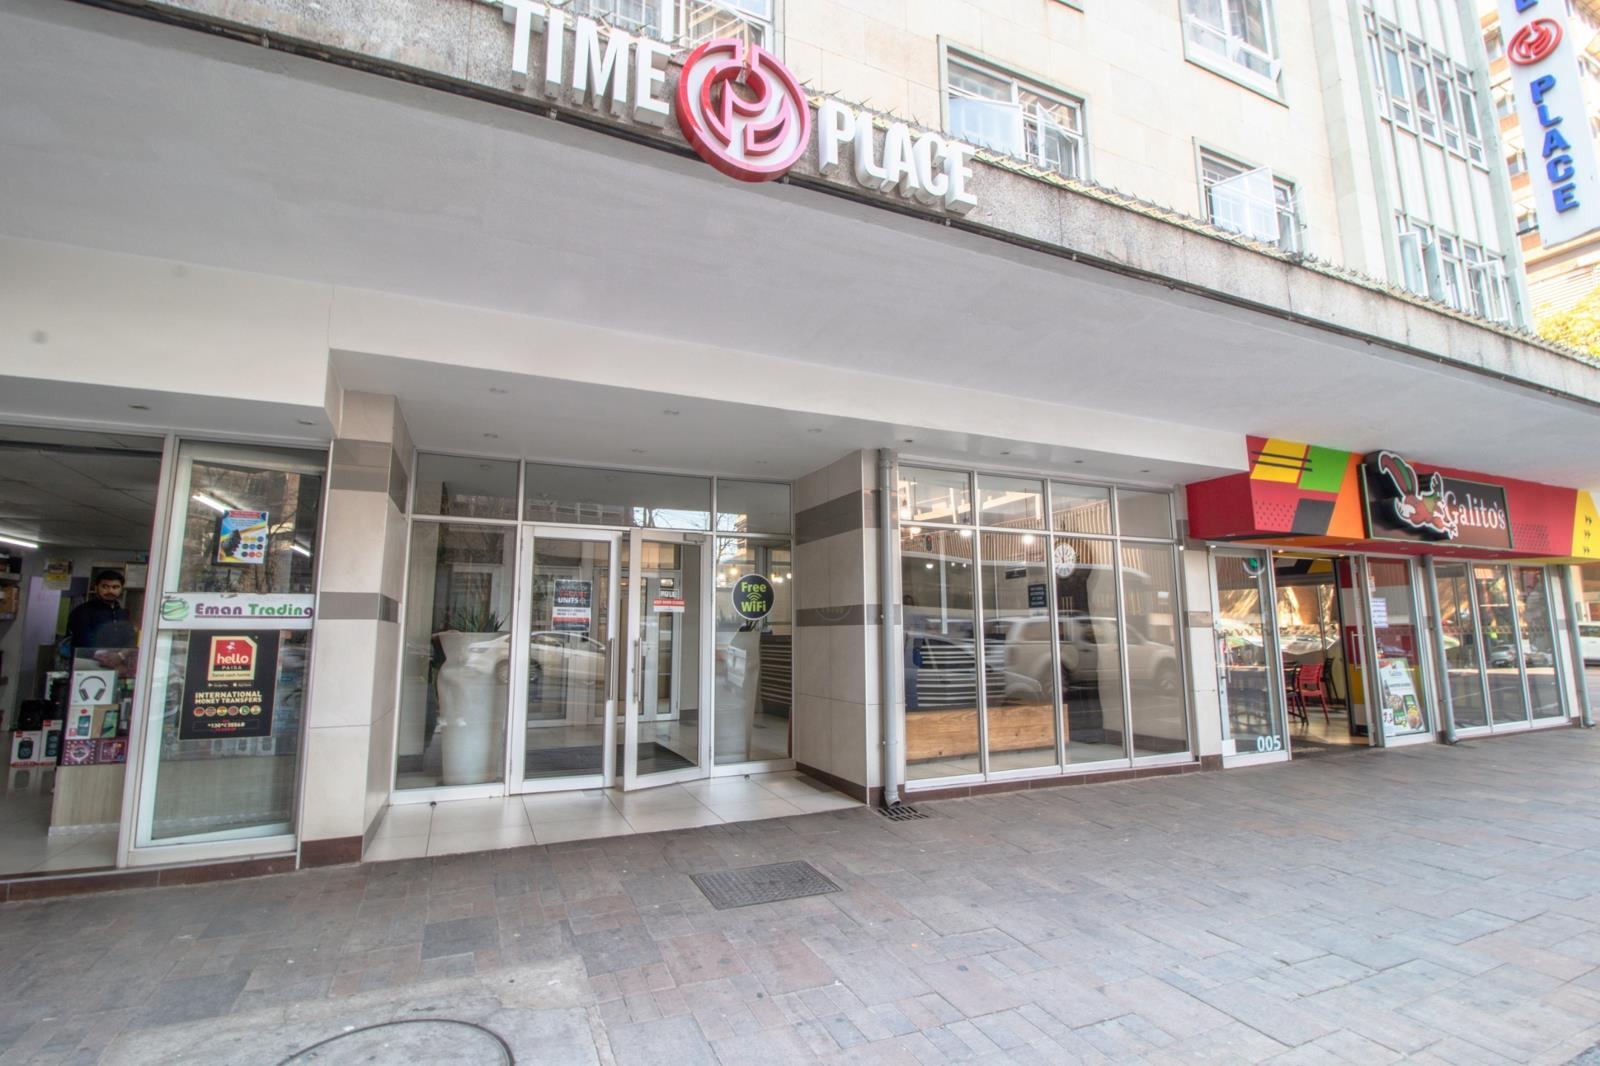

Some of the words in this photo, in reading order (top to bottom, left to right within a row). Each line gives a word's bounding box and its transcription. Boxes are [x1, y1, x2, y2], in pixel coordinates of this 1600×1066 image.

[500, 0, 673, 118] TIME
[818, 98, 978, 212] PLACE
[1529, 74, 1581, 214] PLACE
[1444, 490, 1506, 530] Galito's
[741, 581, 767, 592] Free
[195, 603, 242, 615] Eman
[248, 603, 314, 618] Trading
[741, 601, 767, 612] WiFi
[216, 653, 249, 664] hello
[195, 691, 262, 699] INTERNATIONAL
[1257, 735, 1281, 752] 005
